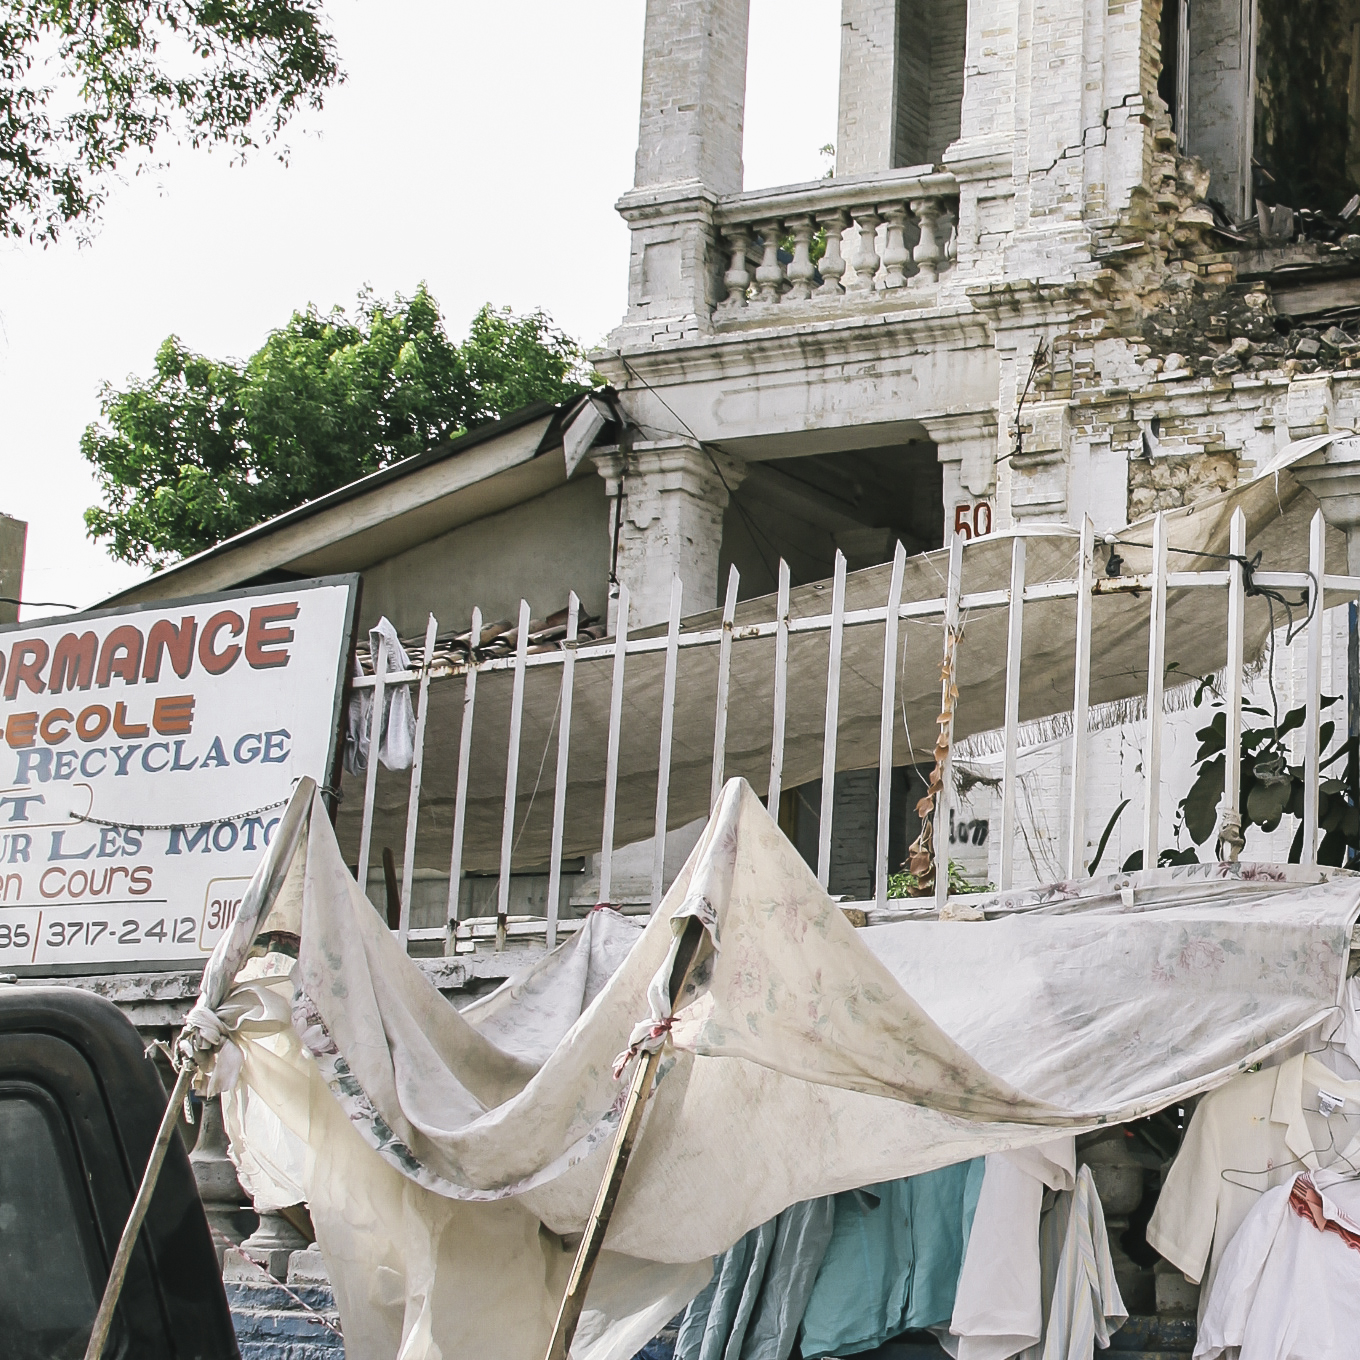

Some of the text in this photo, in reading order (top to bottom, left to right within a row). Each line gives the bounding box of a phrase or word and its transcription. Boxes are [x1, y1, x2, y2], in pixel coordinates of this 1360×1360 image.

[955, 502, 992, 540] 50
[0, 602, 301, 701] RMANCE
[13, 728, 292, 785] RECYCLAGE
[47, 826, 145, 861] LES
[0, 865, 153, 902] n Cours
[46, 917, 197, 948] 3717-2412
